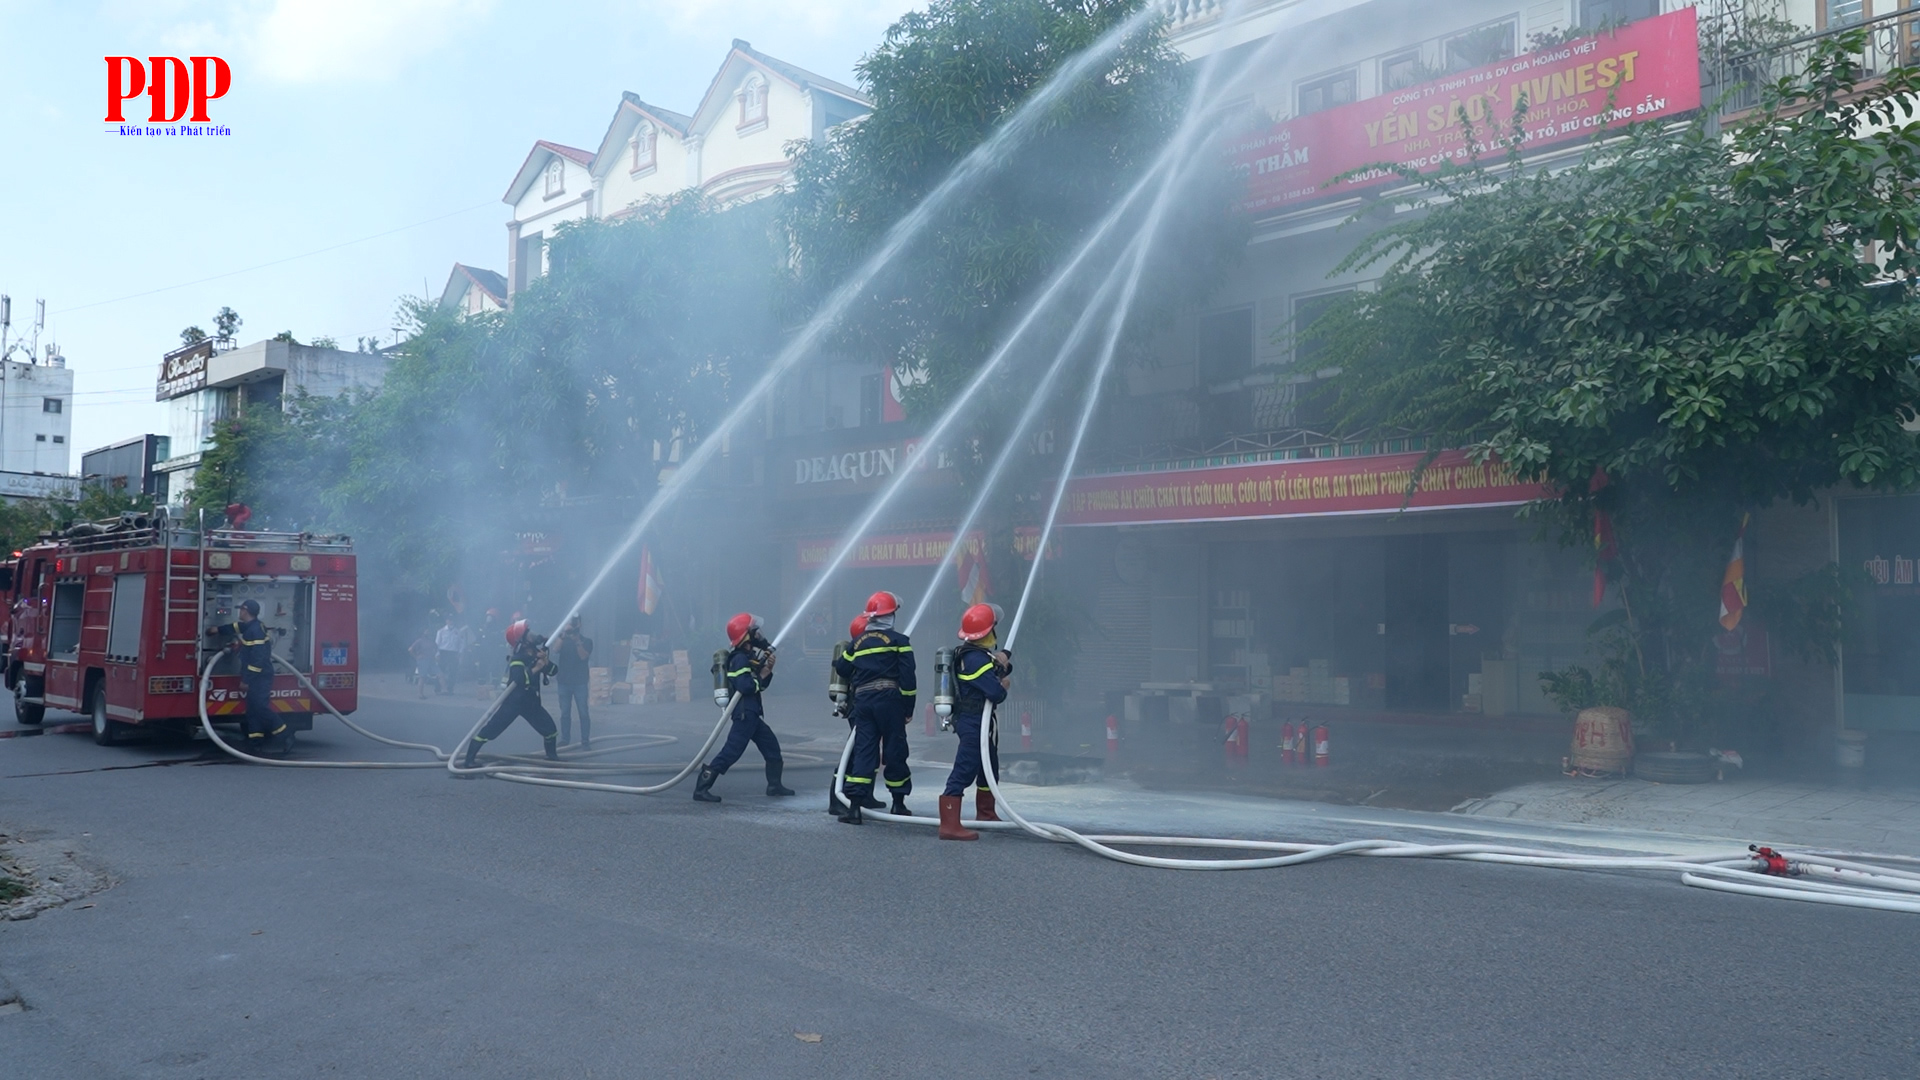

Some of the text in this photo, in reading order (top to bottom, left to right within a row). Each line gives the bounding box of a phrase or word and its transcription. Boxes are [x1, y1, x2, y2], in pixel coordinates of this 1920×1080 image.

[1393, 41, 1598, 105] CÔNG TY TNHH TM & DV GIA HOÀNG VIỆT
[1364, 106, 1419, 148] YẾN
[1426, 94, 1486, 132] SÀO
[1403, 138, 1432, 154] NHA
[1500, 108, 1550, 130] KNH
[1556, 98, 1590, 116] HÒA
[1255, 142, 1310, 175] THẮM
[795, 448, 897, 484] DEAGUN
[1157, 482, 1179, 508] CHÁY
[1180, 481, 1193, 506] VÀ
[1194, 480, 1212, 506] CỨU
[1214, 482, 1237, 509] NẠN,
[1238, 477, 1257, 503] CỨU
[1259, 475, 1272, 507] HỘ
[1274, 470, 1287, 501] TỔ
[1288, 473, 1311, 500] LIÊN
[1312, 476, 1331, 499] GIA
[1333, 475, 1348, 497] AN
[1349, 468, 1378, 497] TOÀN
[1421, 463, 1451, 492] CHÁY
[871, 540, 894, 560] CHÁY
[912, 539, 925, 559] LÀ
[229, 690, 302, 699] EVDIGM
